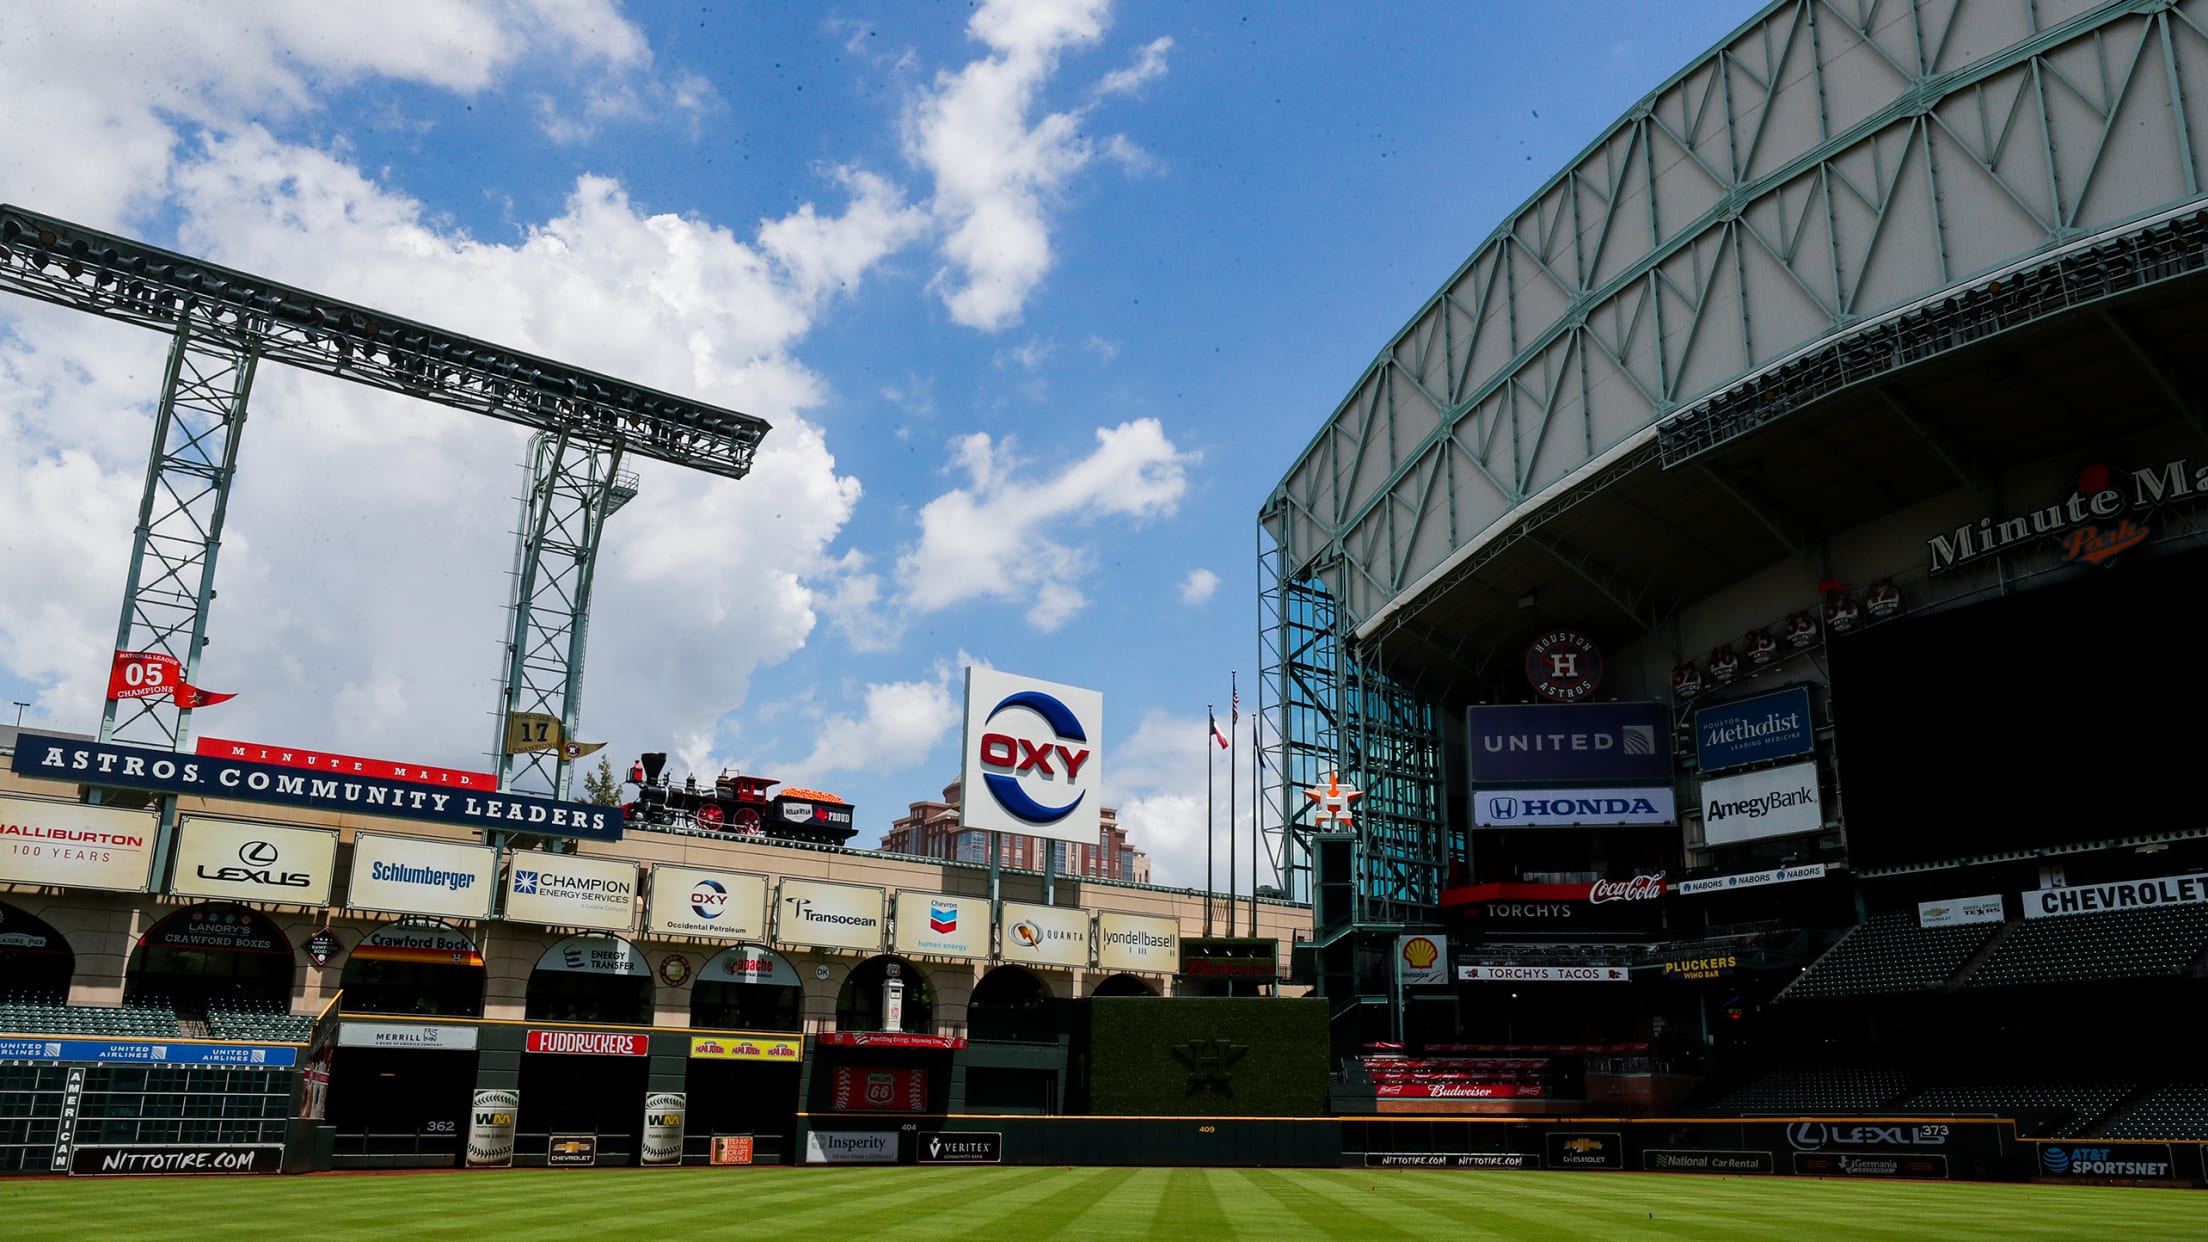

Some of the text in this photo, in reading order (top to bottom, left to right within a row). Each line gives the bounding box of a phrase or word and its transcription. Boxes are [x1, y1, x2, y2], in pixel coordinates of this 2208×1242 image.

[1928, 487, 2120, 573] Minute
[2062, 518, 2147, 563] Park
[1534, 633, 1592, 654] HOUSTON
[153, 655, 178, 666] LEAGUE
[1550, 654, 1578, 678] H
[125, 663, 164, 686] 05
[118, 686, 174, 698] CHAMPIONS
[1540, 680, 1592, 698] ASTROS
[1703, 718, 1740, 729] HOUSTON
[1706, 712, 1800, 747] Methodist
[522, 723, 549, 742] 17
[1484, 733, 1614, 752] UNITED
[1730, 732, 1800, 750] LEADING MEDICINE
[232, 746, 363, 772] MINUTE
[980, 734, 1090, 778] OXY
[218, 768, 450, 812] COMMUNITY
[465, 798, 605, 830] LEADERS
[1707, 786, 1813, 822] AmegyBank
[1522, 798, 1658, 816] HONDA
[828, 812, 850, 822] PROUD
[12, 844, 111, 862] 100 YEARS
[197, 864, 311, 888] LEXUS
[372, 861, 476, 891] Schlumberger
[1692, 868, 1820, 890] NABORS NABORS NABORS
[540, 874, 630, 894] CHAMPION
[540, 888, 629, 904] ENERGY SERVICES
[691, 893, 728, 906] OXY
[930, 900, 958, 909] Chevron
[1487, 904, 1571, 918] TORCHYS
[803, 909, 876, 928] Transocean
[189, 923, 251, 934] LANDRY'S
[667, 921, 746, 934] Occidental Petroleum
[165, 934, 270, 949] CRAWFORD BOXES
[372, 934, 468, 950] Crawford Bock
[1047, 929, 1084, 942] QUANTA
[1104, 928, 1176, 948] lyondellbasell
[918, 940, 968, 952] human energy
[591, 950, 626, 960] ENERGY
[591, 960, 634, 970] TRANSFER
[738, 958, 773, 972] apache
[816, 968, 828, 976] DK
[1665, 956, 1737, 973] PLUCKERS
[1488, 968, 1600, 978] TORCHYS TACOS
[1684, 970, 1720, 980] WING BAR
[376, 1033, 420, 1042] MERRILL
[540, 1031, 634, 1054] FUDDRUCKERS
[870, 1075, 892, 1083] PHILLIPS
[870, 1086, 890, 1098] 66
[1428, 1084, 1492, 1097] Budweiser
[56, 1072, 80, 1166] AMERICAN
[427, 1121, 455, 1132] 362
[476, 1113, 512, 1125] WM
[648, 1114, 680, 1126] WM
[1832, 1126, 1946, 1144] LEXUS
[1922, 1125, 1949, 1136] 373
[828, 1135, 886, 1152] Insperity
[944, 1143, 990, 1152] VERITEX
[102, 1150, 255, 1171] NITTOTIRE.COM
[1382, 1156, 1522, 1166] NITTOTIRE.COM NITTOTIRE.COM
[1668, 1155, 1759, 1168] National Car Rental
[2071, 1148, 2110, 1161] AT&T
[1855, 1158, 1898, 1168] Germania
[2072, 1161, 2168, 1176] SPORTSNET
